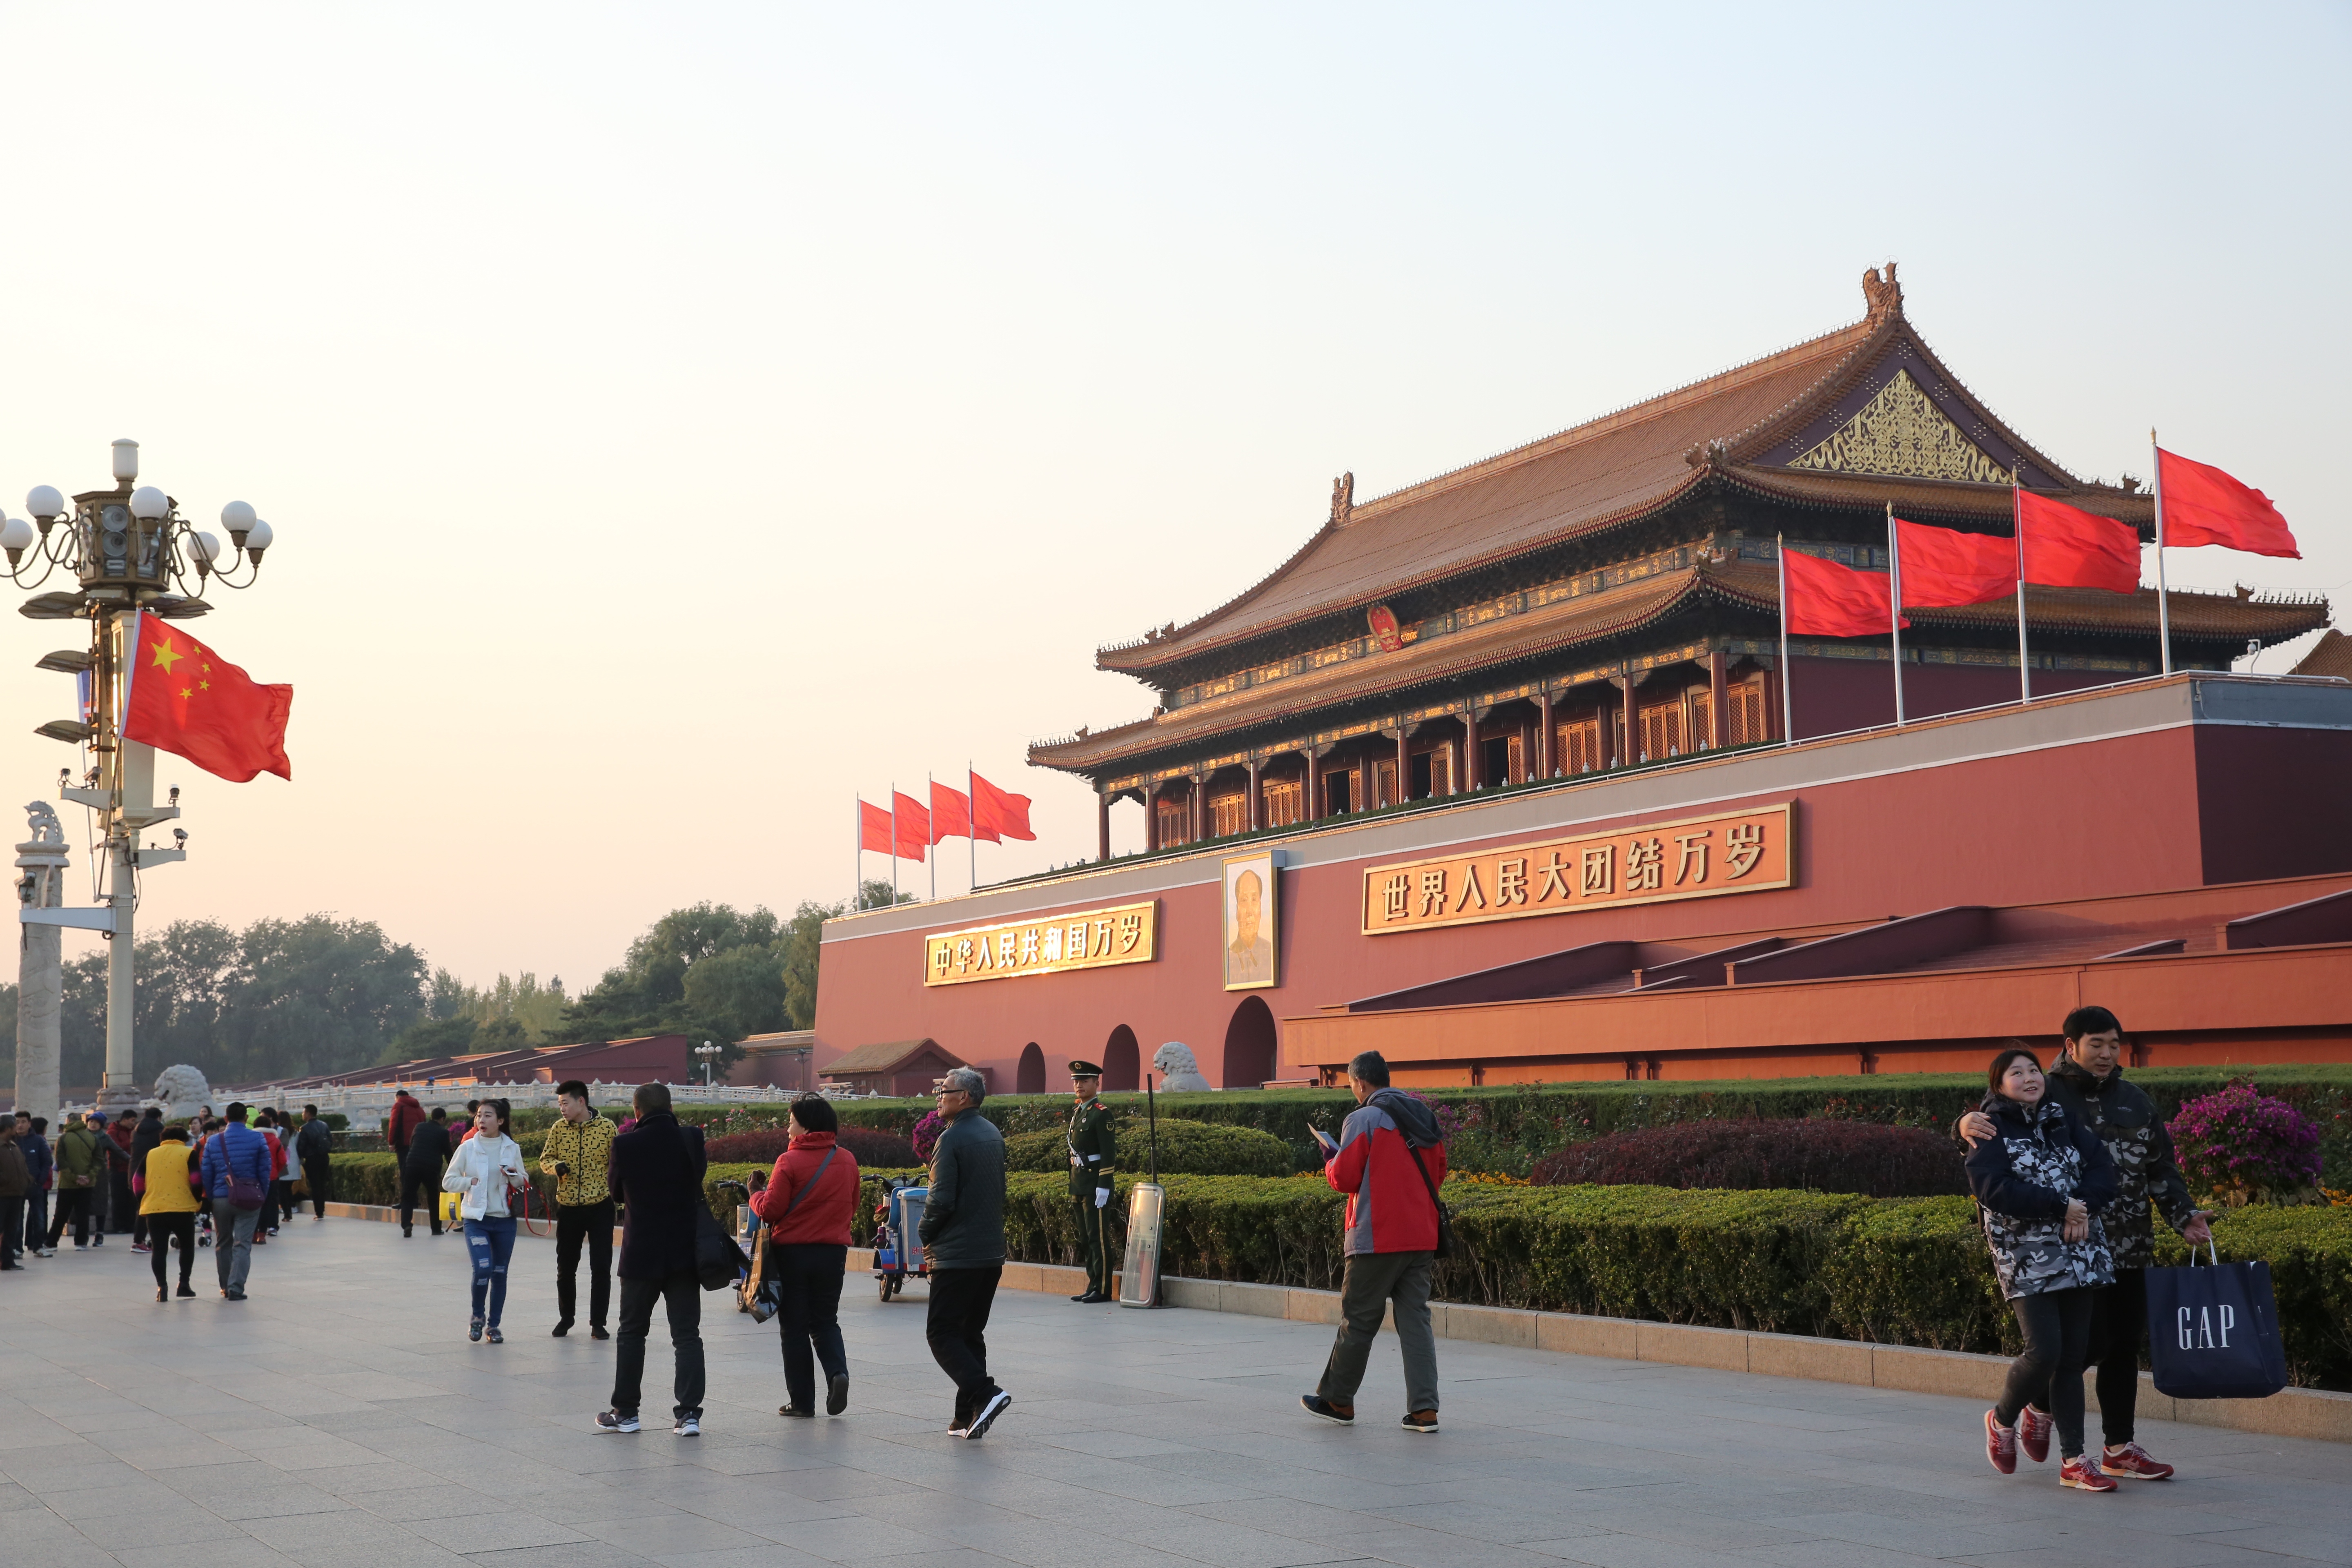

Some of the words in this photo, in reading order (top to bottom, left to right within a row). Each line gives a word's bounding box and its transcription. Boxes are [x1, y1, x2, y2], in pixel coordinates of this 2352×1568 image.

[1382, 824, 1762, 921] 世界人民大团结万岁
[935, 915, 1141, 976] 中华人民共和国万岁
[2178, 1305, 2234, 1350] GAP
